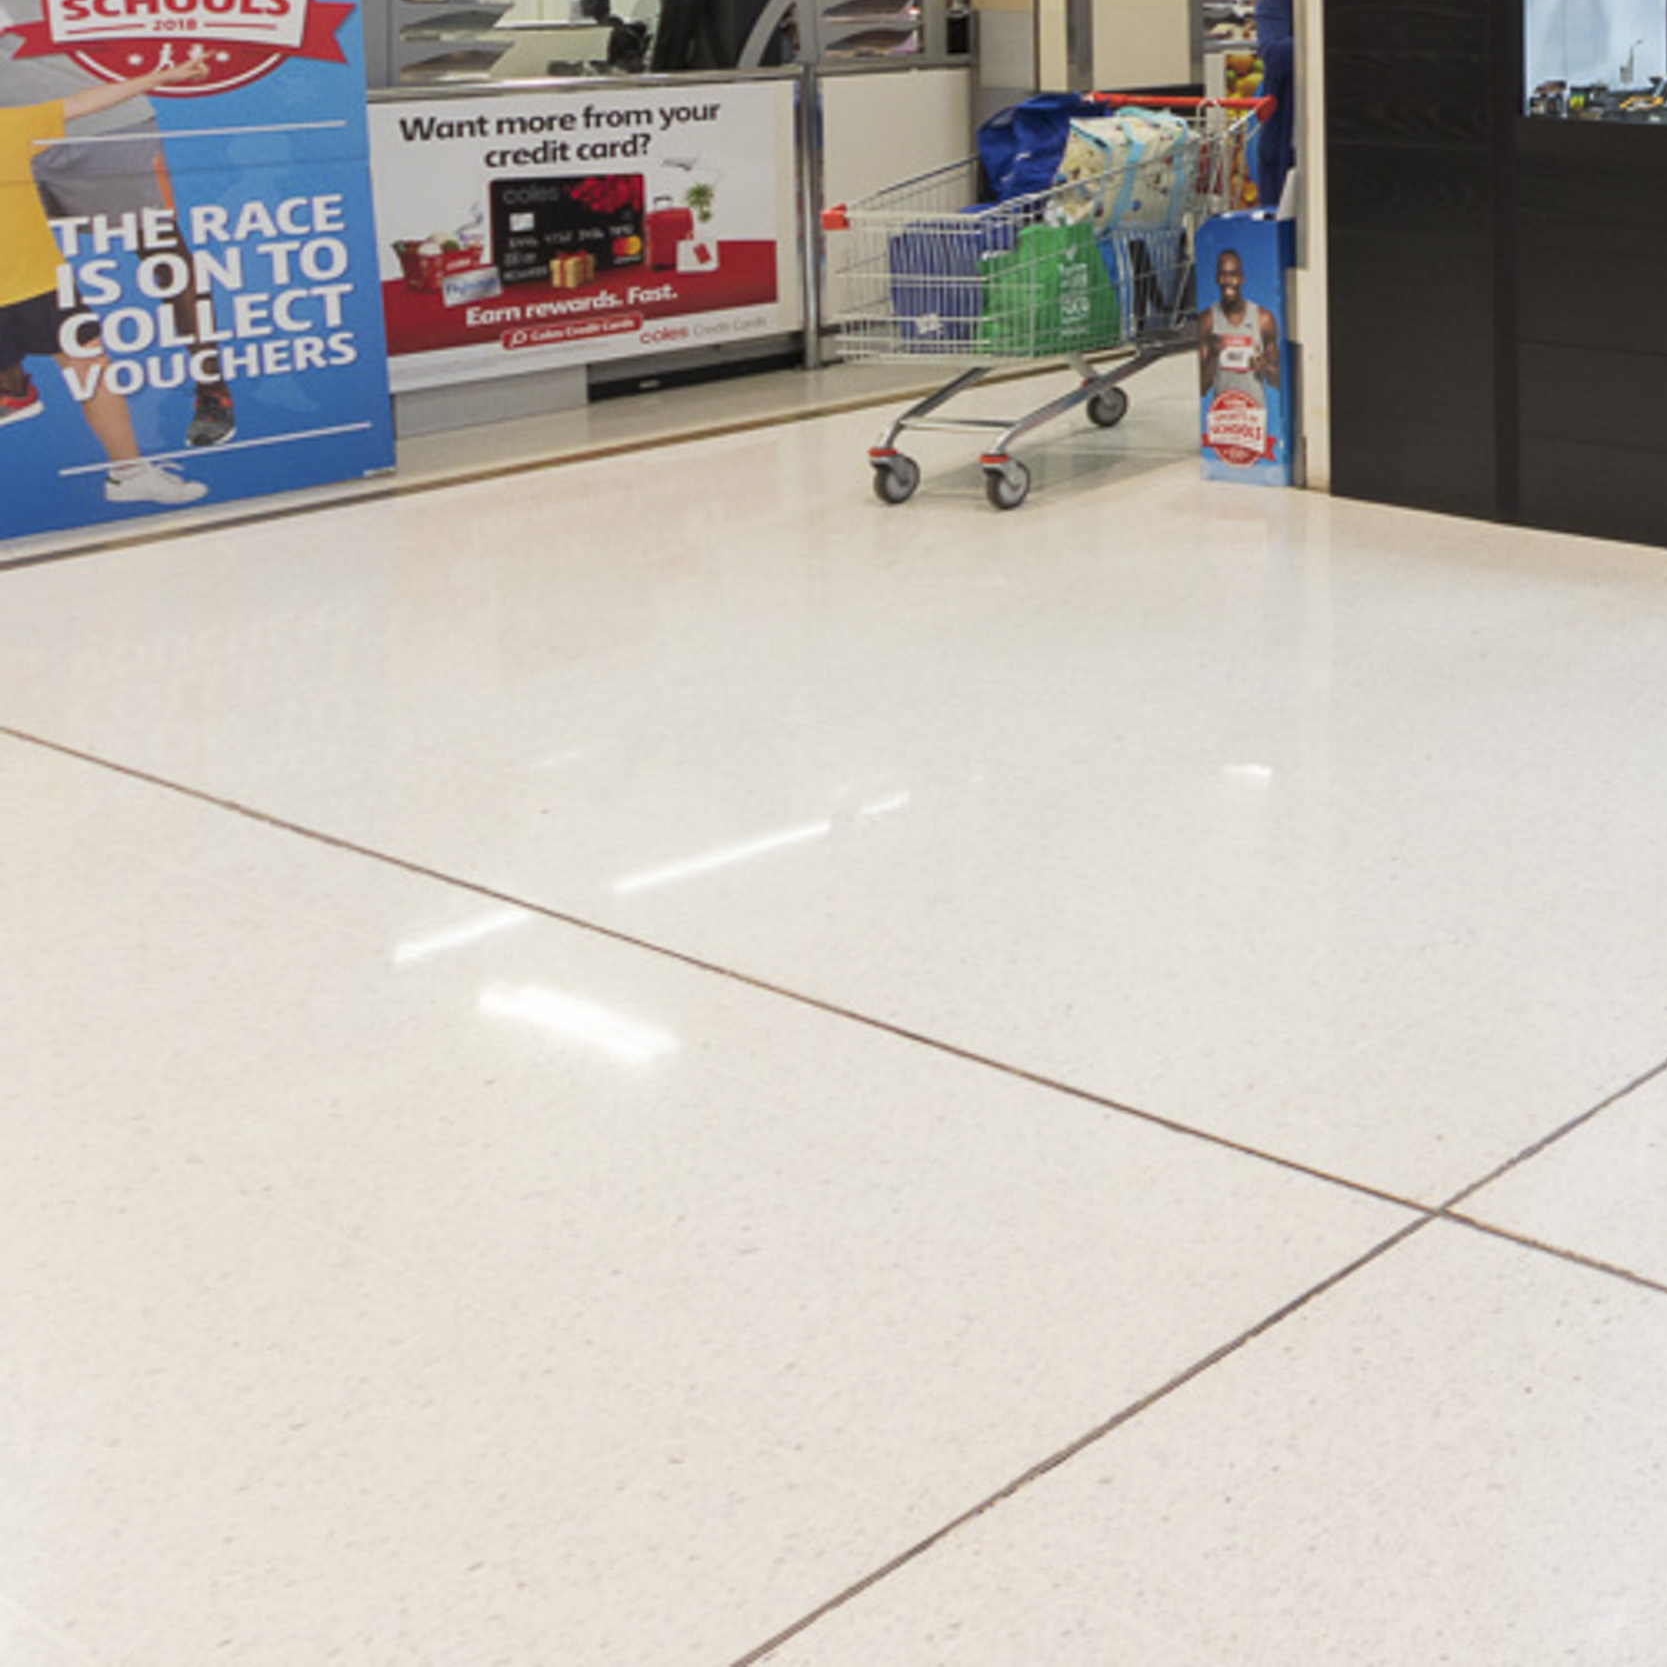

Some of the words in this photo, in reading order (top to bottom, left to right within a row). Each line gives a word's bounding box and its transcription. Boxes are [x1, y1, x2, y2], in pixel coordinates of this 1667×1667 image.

[152, 19, 198, 32] 2018
[400, 116, 490, 142] Want
[497, 110, 577, 135] more
[583, 105, 654, 130] from
[660, 102, 720, 131] your
[484, 137, 571, 169] credit
[577, 134, 651, 162] card?
[50, 207, 175, 257] THE
[190, 193, 345, 242] RACE
[56, 258, 121, 310] IS
[136, 246, 243, 300] ON
[257, 236, 348, 287] TO
[58, 283, 354, 360] COLLECT
[466, 304, 522, 328] Earn
[526, 289, 622, 320] rewards.
[627, 282, 678, 305] Fast.
[63, 333, 358, 404] VOUCHERS
